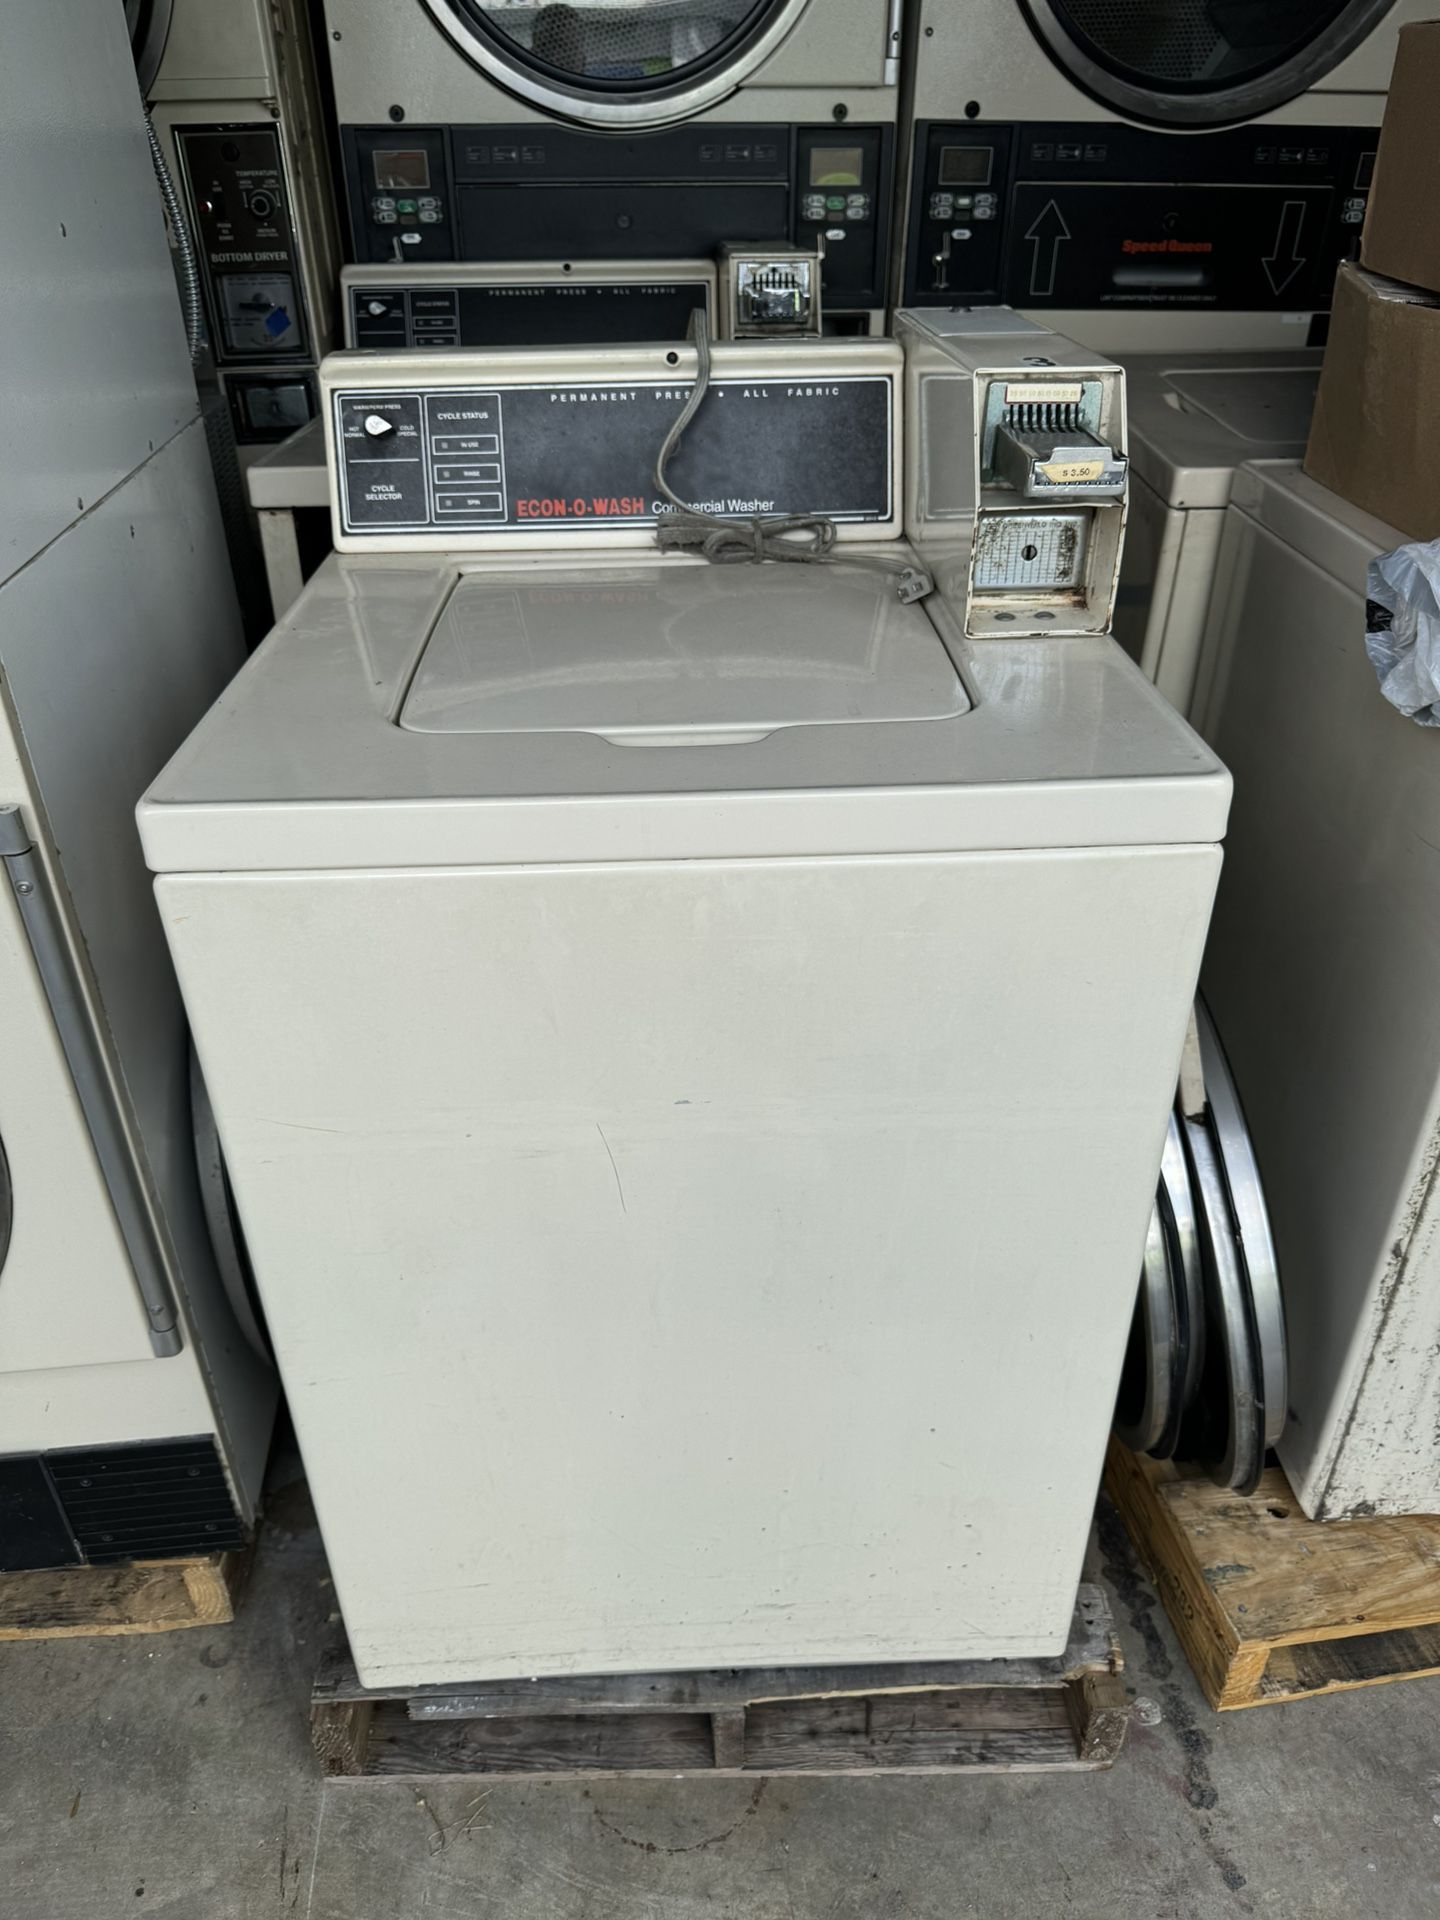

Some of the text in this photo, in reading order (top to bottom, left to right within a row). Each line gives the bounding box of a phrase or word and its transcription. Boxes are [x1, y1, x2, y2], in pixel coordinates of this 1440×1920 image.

[1122, 239, 1212, 255] Speed Queen
[211, 250, 288, 263] BOTTOM DRYER
[550, 387, 840, 402] PERMANENT PRES ALL FABRIC
[436, 411, 489, 421] CYCLE STATUS
[1070, 468, 1090, 477] 3.50
[371, 485, 396, 493] CYCLE
[365, 492, 403, 501] SELECTOR
[516, 497, 645, 517] ECON-O-WASH
[727, 498, 775, 512] Washer
